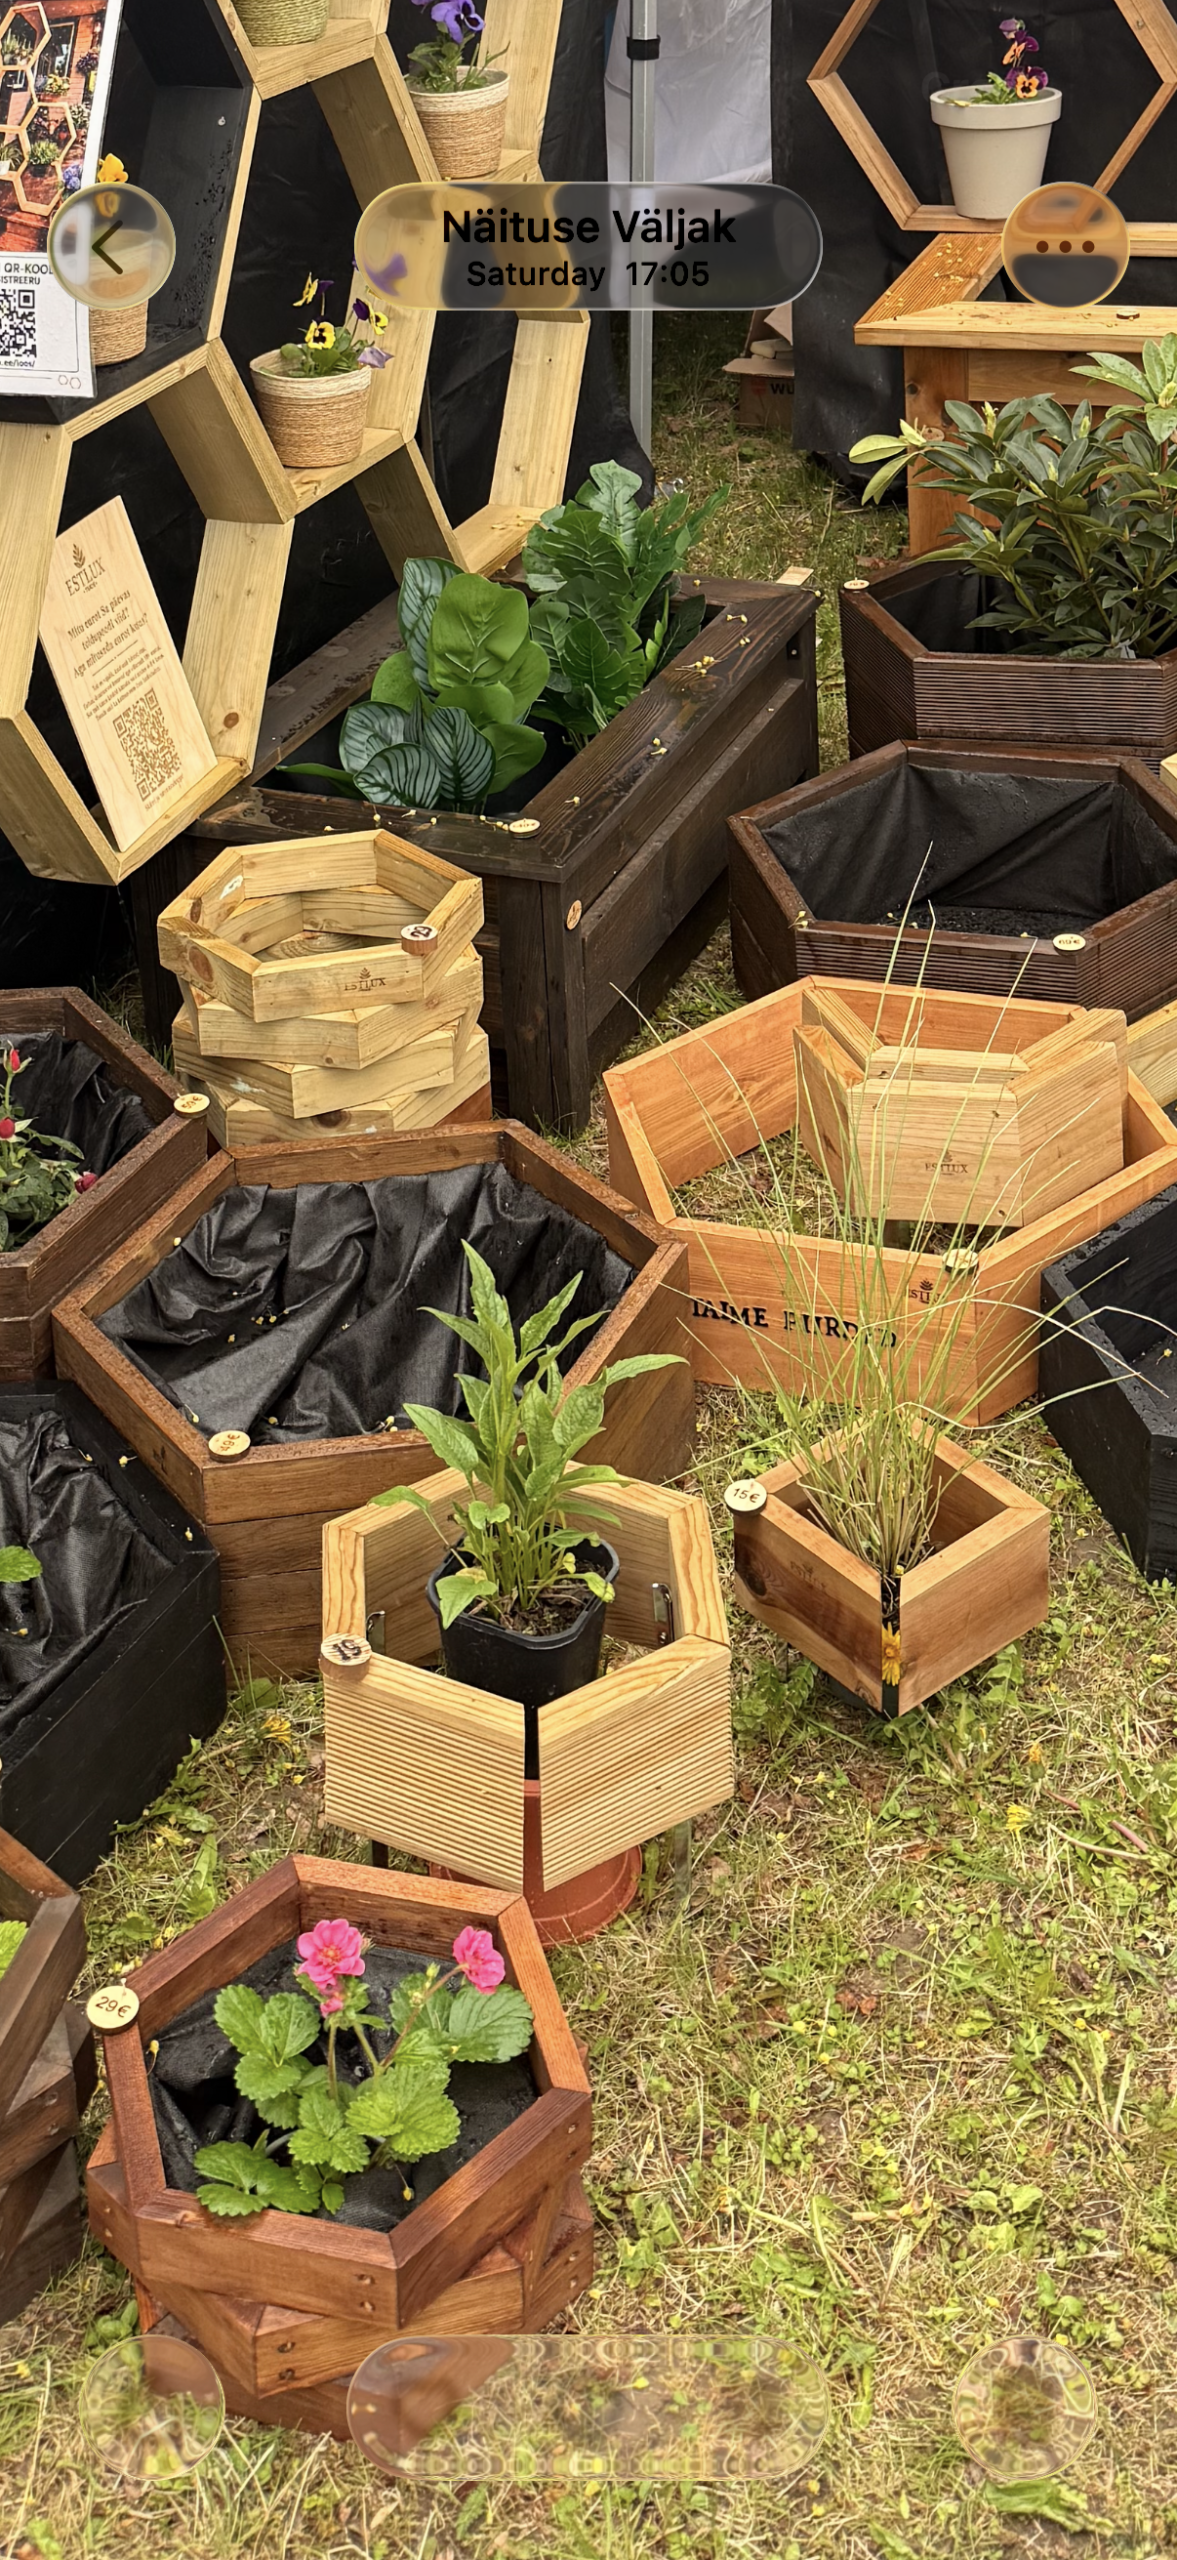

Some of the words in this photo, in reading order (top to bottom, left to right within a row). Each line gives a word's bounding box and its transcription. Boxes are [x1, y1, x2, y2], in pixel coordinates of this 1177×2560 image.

[0, 275, 41, 285] ISTREERU
[65, 557, 106, 596] ESTLUX
[67, 622, 85, 641] Mitu
[84, 612, 101, 629] eurot
[100, 605, 110, 617] Sa
[110, 589, 131, 613] päevas
[114, 607, 130, 626] viid?
[73, 662, 86, 679] Aga
[113, 628, 130, 646] eurot
[733, 1488, 760, 1503] 15€
[95, 1996, 131, 2018] 29€
